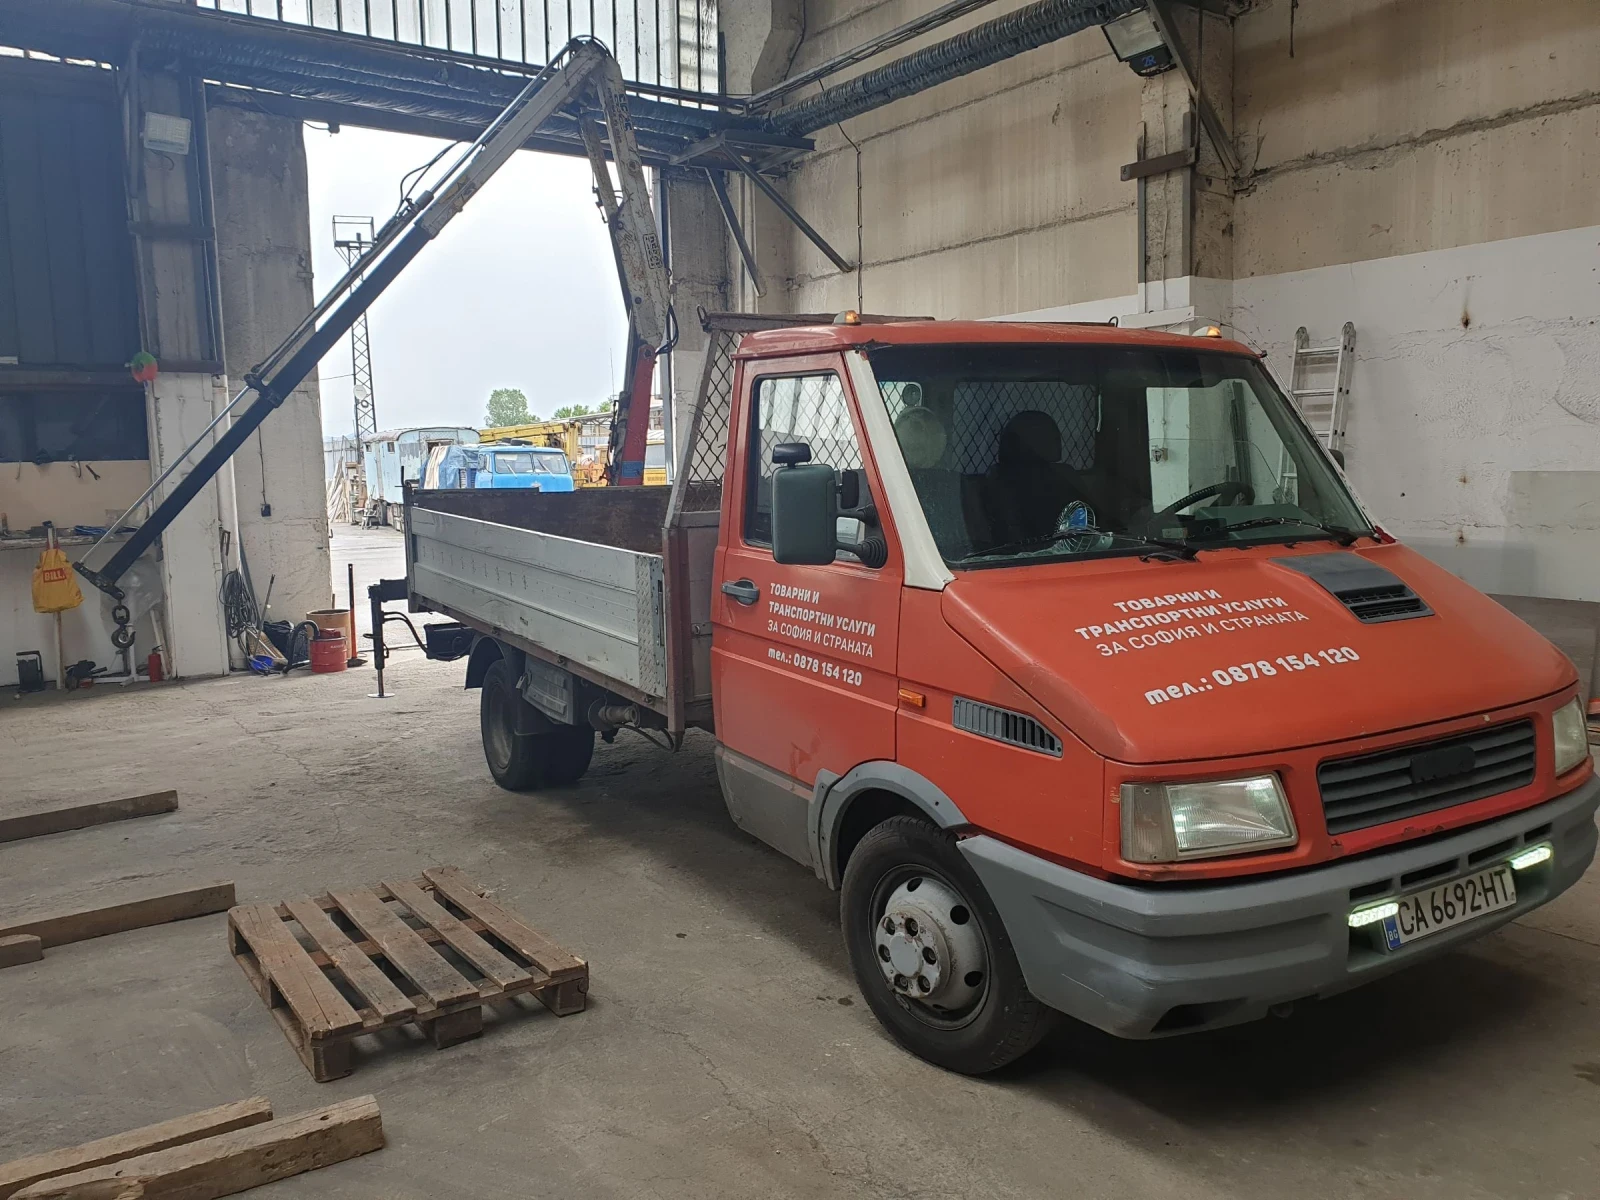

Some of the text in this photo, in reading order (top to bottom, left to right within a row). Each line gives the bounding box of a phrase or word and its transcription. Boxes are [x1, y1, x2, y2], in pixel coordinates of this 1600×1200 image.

[45, 571, 65, 581] BILL
[770, 582, 820, 604] ТОВАРНИ И
[1113, 589, 1222, 613] ТОВАРНИ И
[768, 601, 876, 637] ТРАНСПОРТНИ УСЛУГИ
[1074, 596, 1289, 640] ТРАНСПОРТНИ УСЛУГИ
[1096, 610, 1310, 657] ЗА СОФИЯ И СТРАНАТА
[767, 619, 873, 658] ЗА СОФИЯ И СТРАНАТА
[793, 655, 819, 673] 0878
[821, 662, 840, 680] 154
[842, 668, 862, 686] 120
[1212, 660, 1277, 686] 0878
[1276, 652, 1321, 672] 154
[1318, 646, 1360, 664] 120
[1388, 928, 1399, 941] BG
